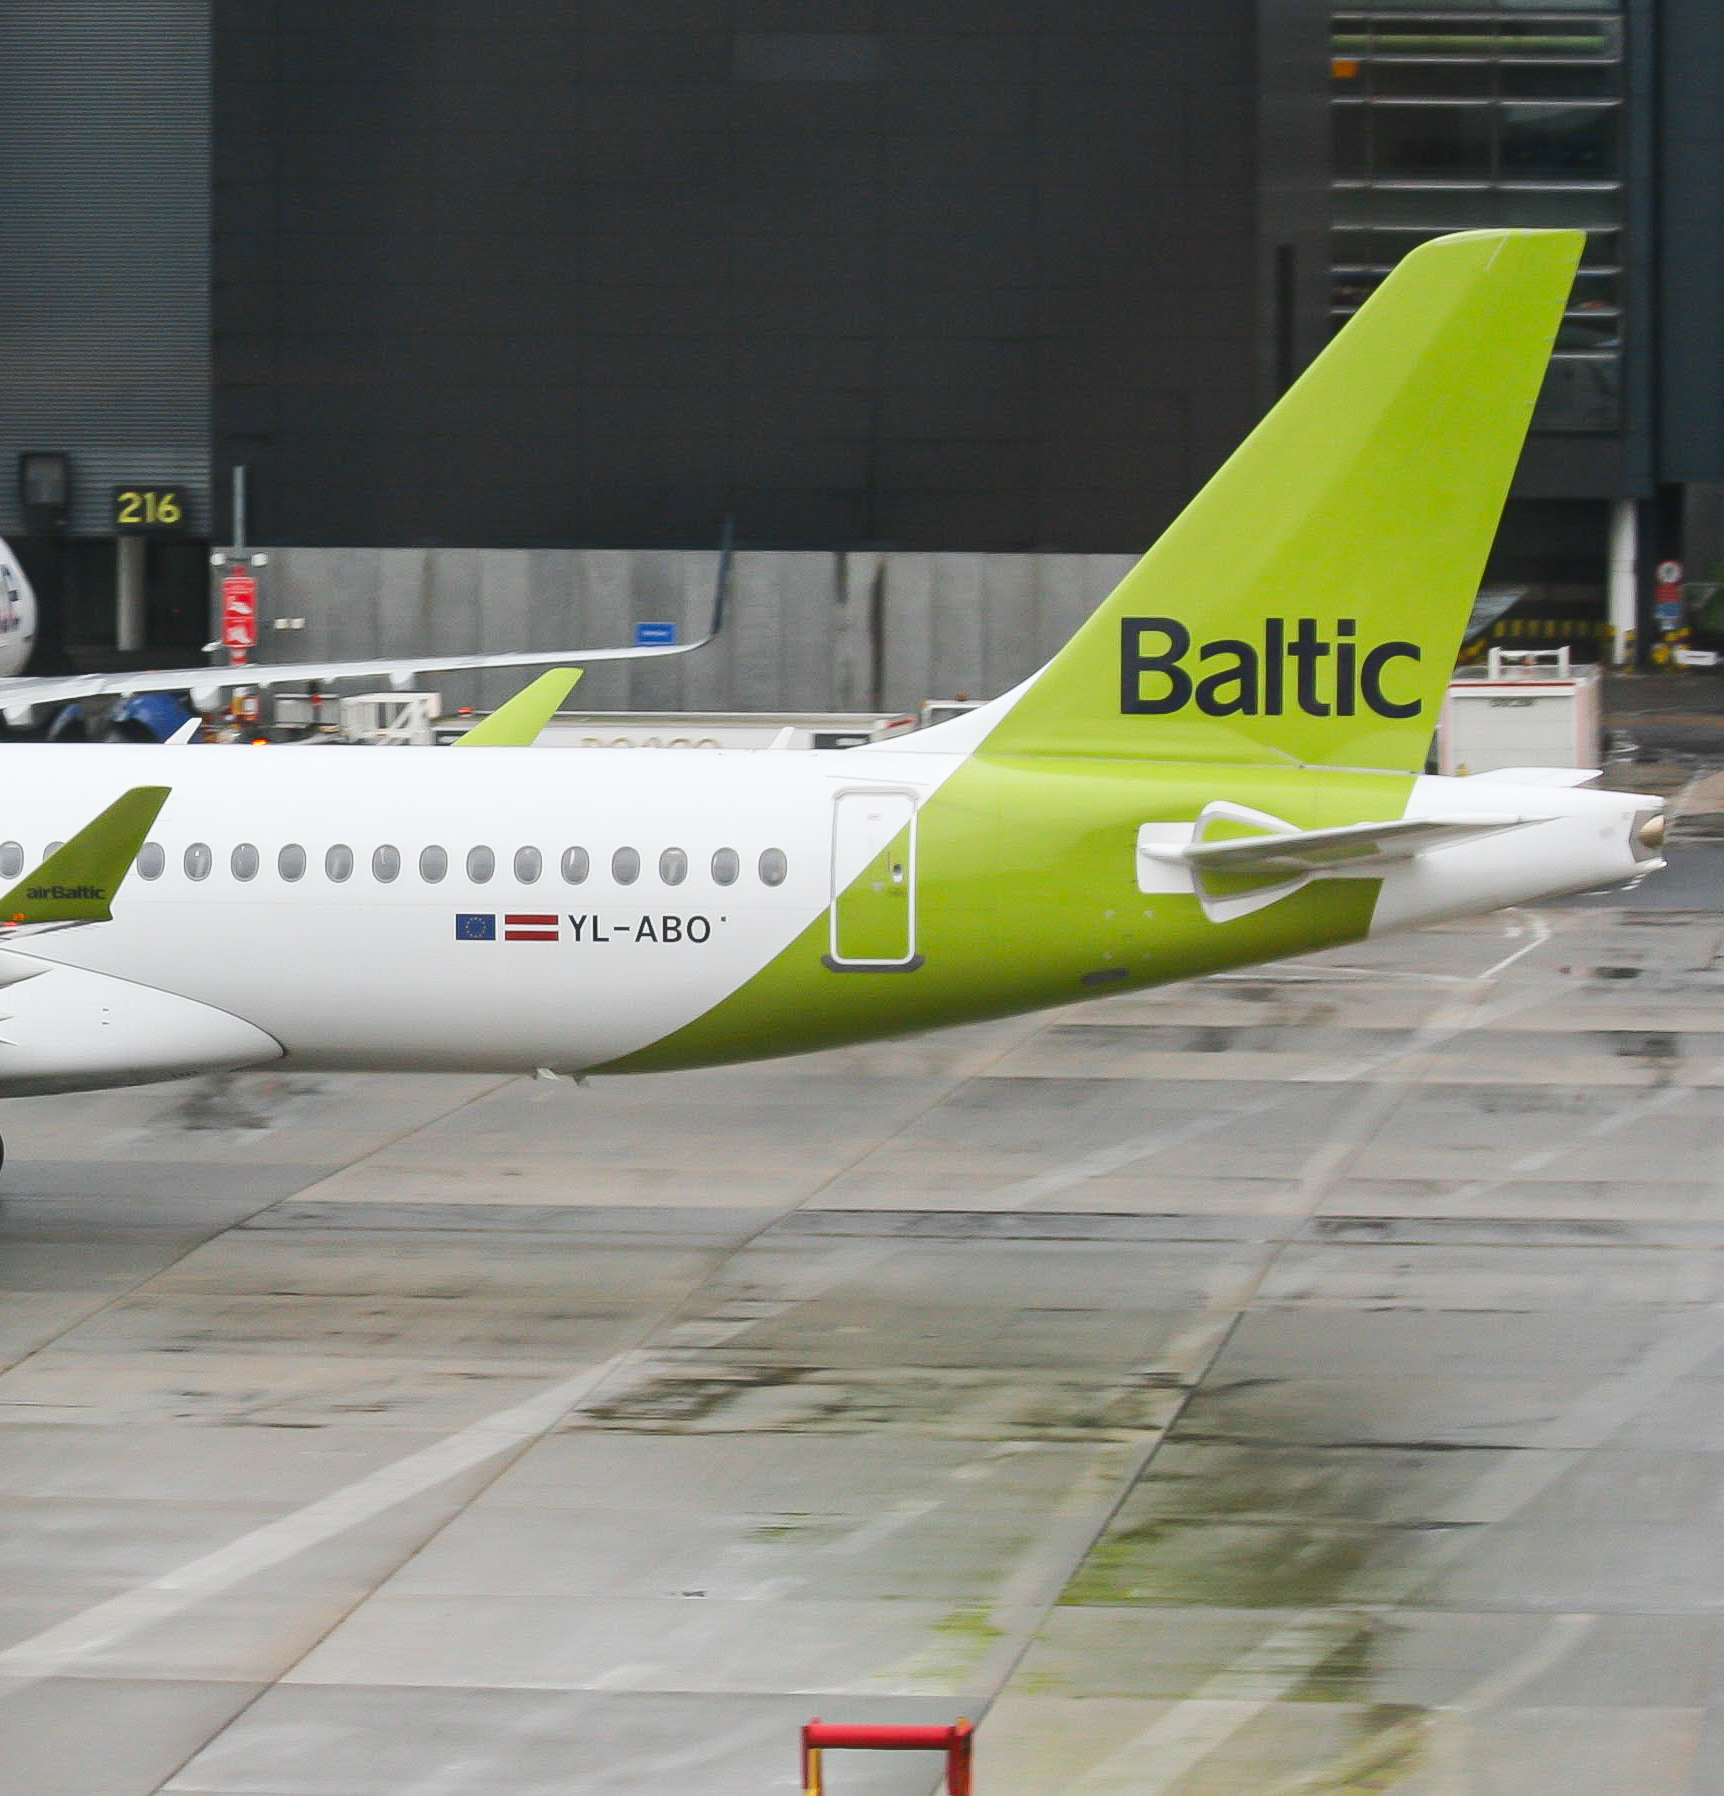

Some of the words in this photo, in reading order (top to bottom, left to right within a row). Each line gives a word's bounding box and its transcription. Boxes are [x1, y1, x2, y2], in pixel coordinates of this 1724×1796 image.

[116, 491, 182, 523] 216
[1120, 617, 1422, 718] Baltic
[27, 885, 106, 900] airBaltic
[567, 914, 712, 943] YL-ABO
